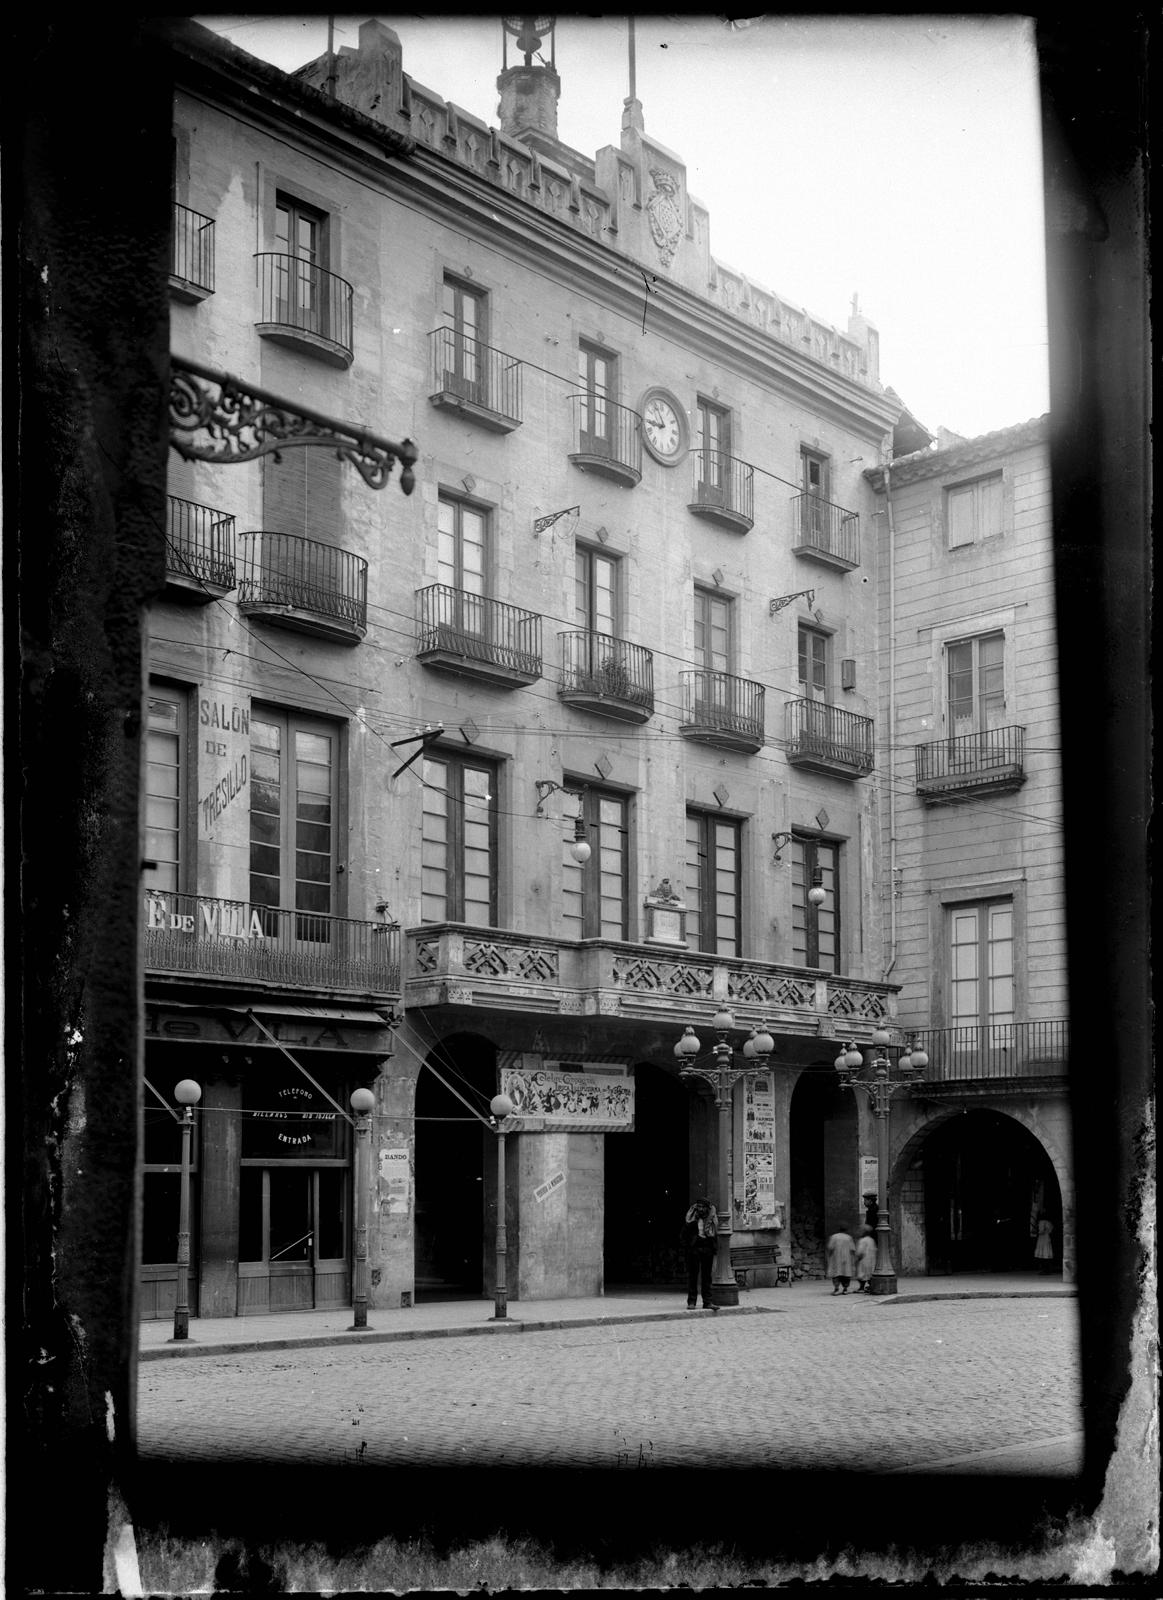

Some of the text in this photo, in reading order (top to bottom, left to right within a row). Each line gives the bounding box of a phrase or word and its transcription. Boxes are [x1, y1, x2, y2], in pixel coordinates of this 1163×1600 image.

[205, 740, 226, 757] DE
[202, 753, 247, 832] TRESILLO
[169, 913, 195, 933] DE
[278, 1133, 312, 1145] ENTRADA
